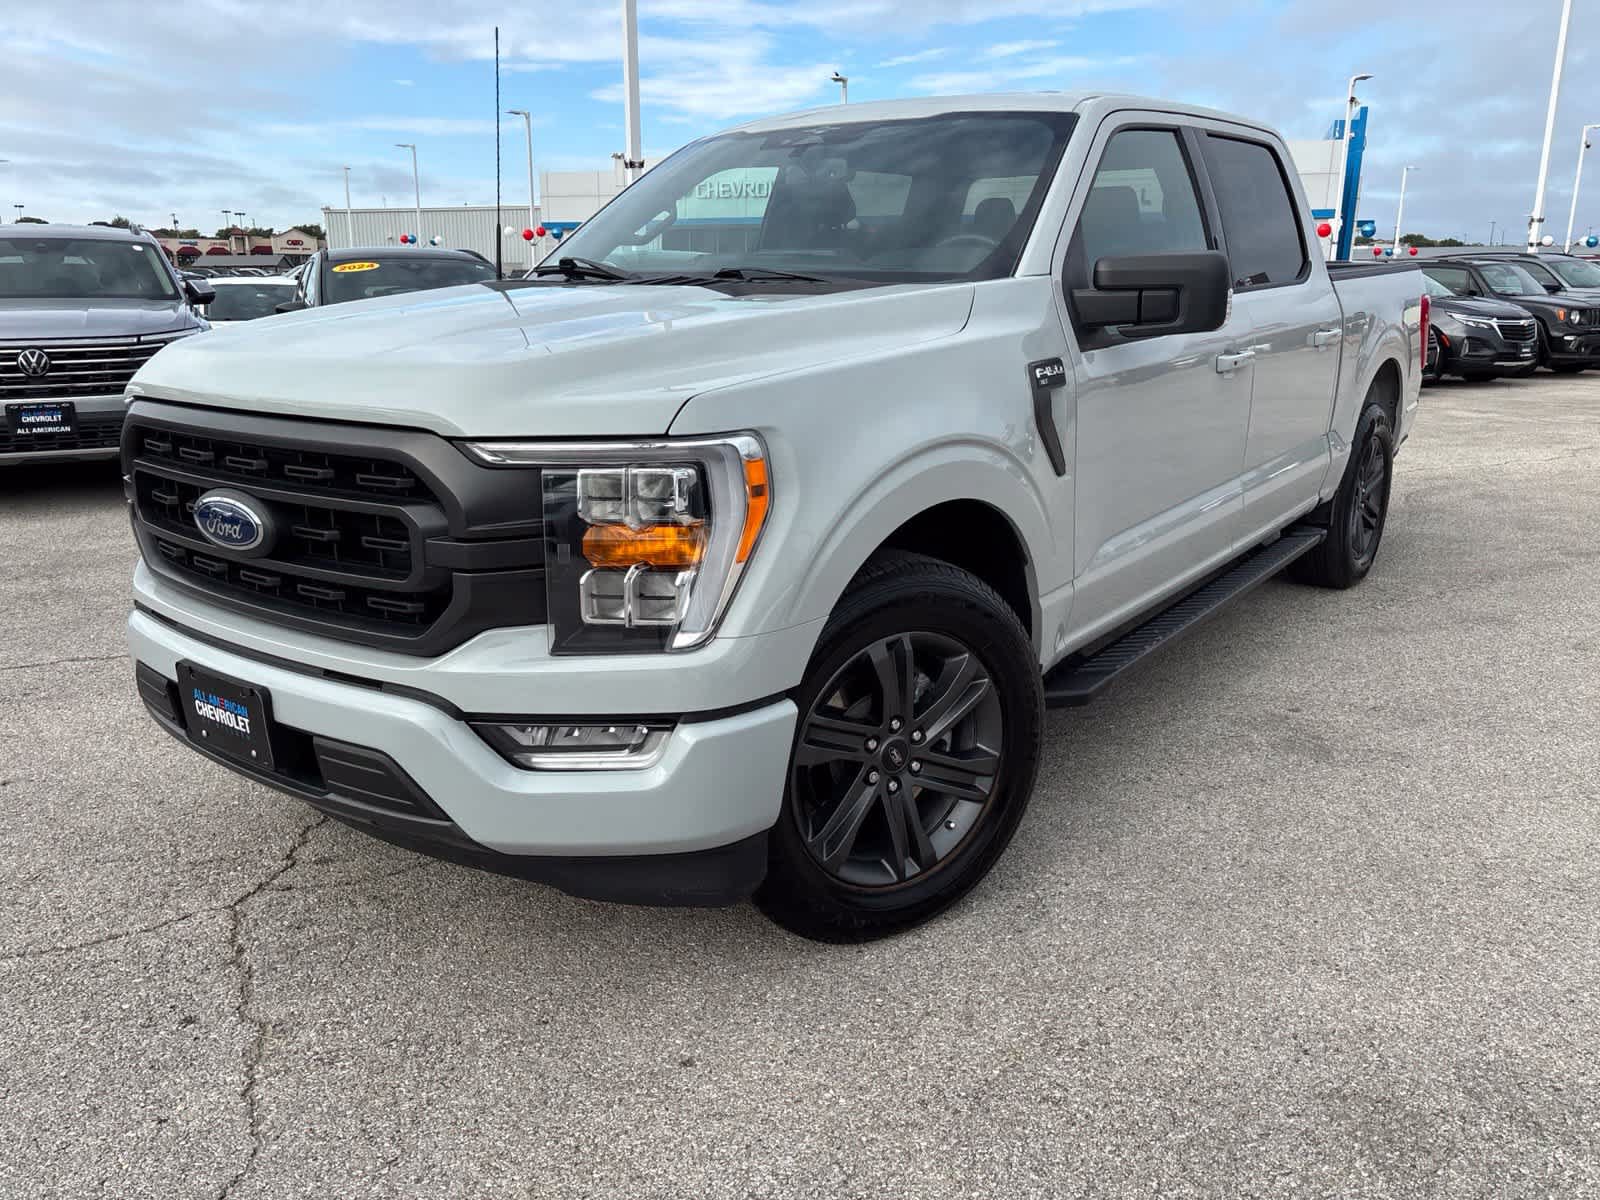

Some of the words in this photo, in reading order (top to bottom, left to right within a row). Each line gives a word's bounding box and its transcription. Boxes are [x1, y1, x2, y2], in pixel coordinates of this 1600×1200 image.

[695, 181, 774, 199] CHEVRO
[32, 425, 71, 433] AMERICAN
[206, 507, 243, 539] Ford
[193, 687, 207, 702] ALL
[208, 691, 249, 718] AMERICAN
[195, 699, 250, 734] CHEVROLET
